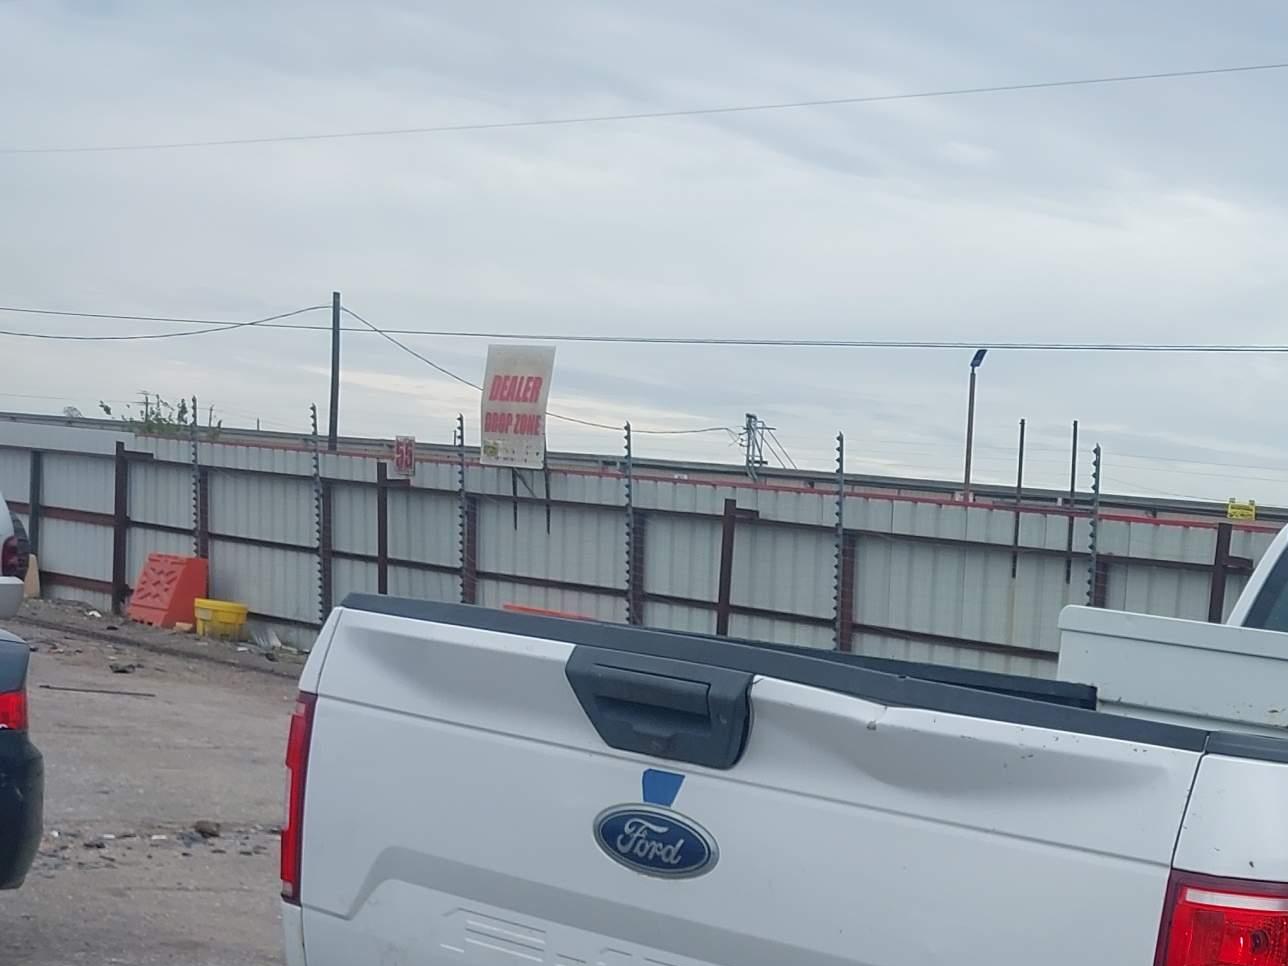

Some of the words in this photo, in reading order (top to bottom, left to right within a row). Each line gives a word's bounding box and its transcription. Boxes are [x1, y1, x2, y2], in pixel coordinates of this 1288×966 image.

[488, 375, 543, 403] DEALER
[484, 411, 513, 434] DROP
[513, 413, 542, 436] ZONE
[617, 818, 684, 865] Ford
